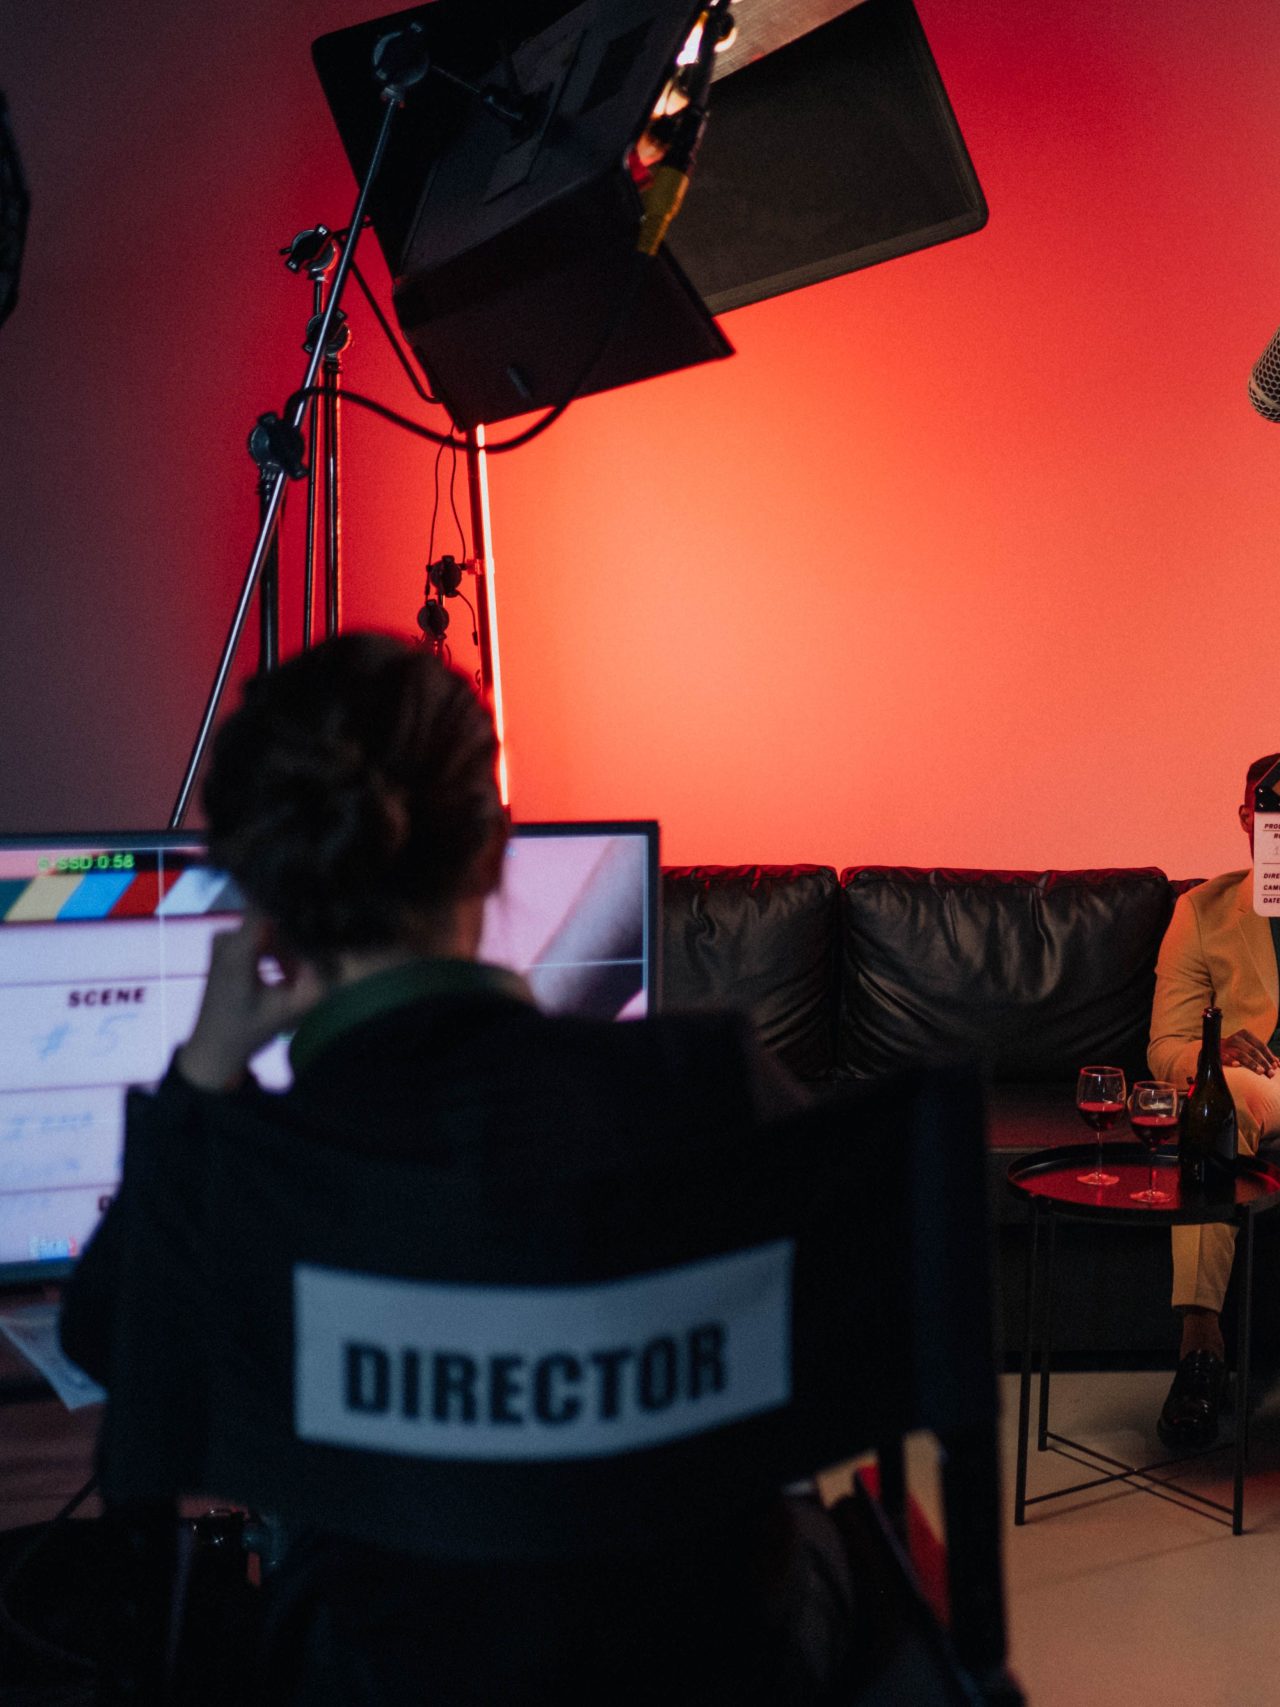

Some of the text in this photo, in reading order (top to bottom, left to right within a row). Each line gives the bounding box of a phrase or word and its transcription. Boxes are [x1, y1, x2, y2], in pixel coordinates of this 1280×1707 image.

[56, 854, 93, 869] SSD
[68, 986, 146, 1008] SCENE
[343, 1321, 728, 1426] DIRECTOR
